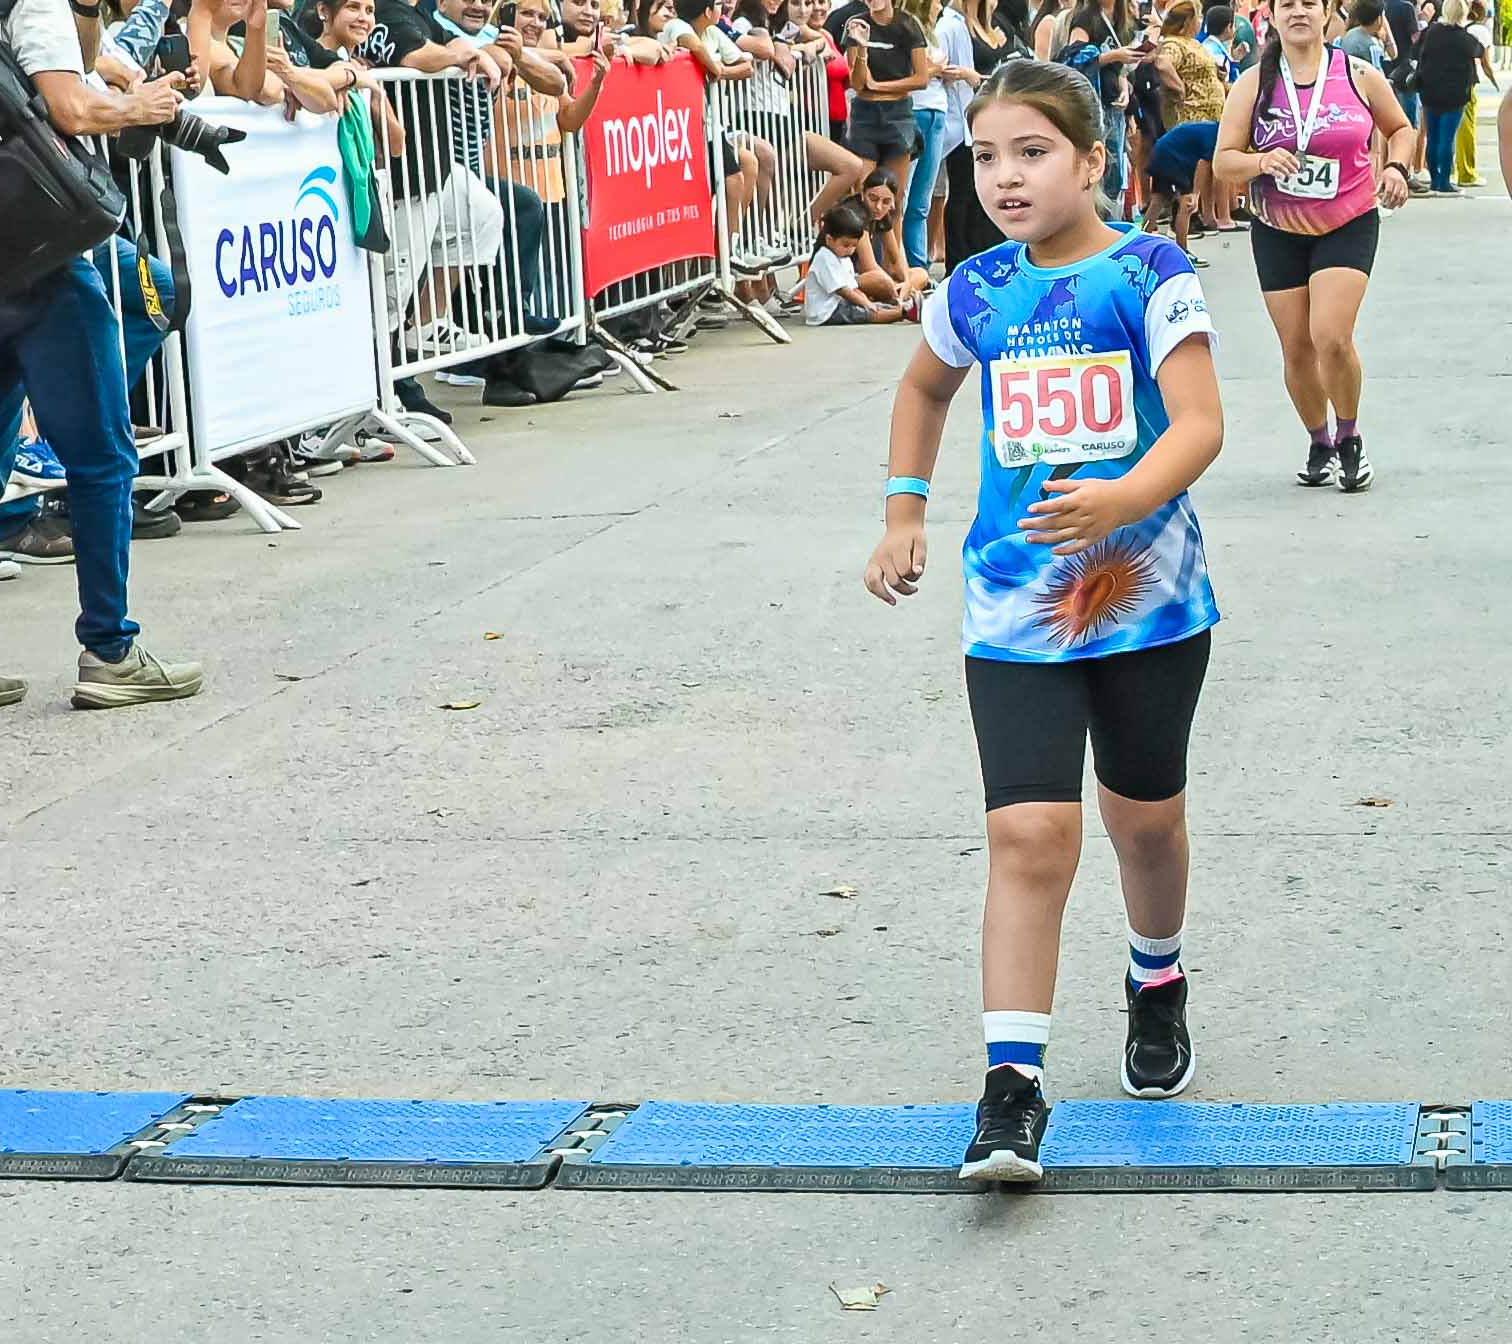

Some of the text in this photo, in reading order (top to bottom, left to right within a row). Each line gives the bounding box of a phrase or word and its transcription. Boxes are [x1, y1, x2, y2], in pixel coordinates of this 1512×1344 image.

[603, 89, 693, 189] moplex
[215, 214, 337, 298] CARUSO
[999, 364, 1123, 438] 550
[1081, 440, 1126, 451] CARUSO
